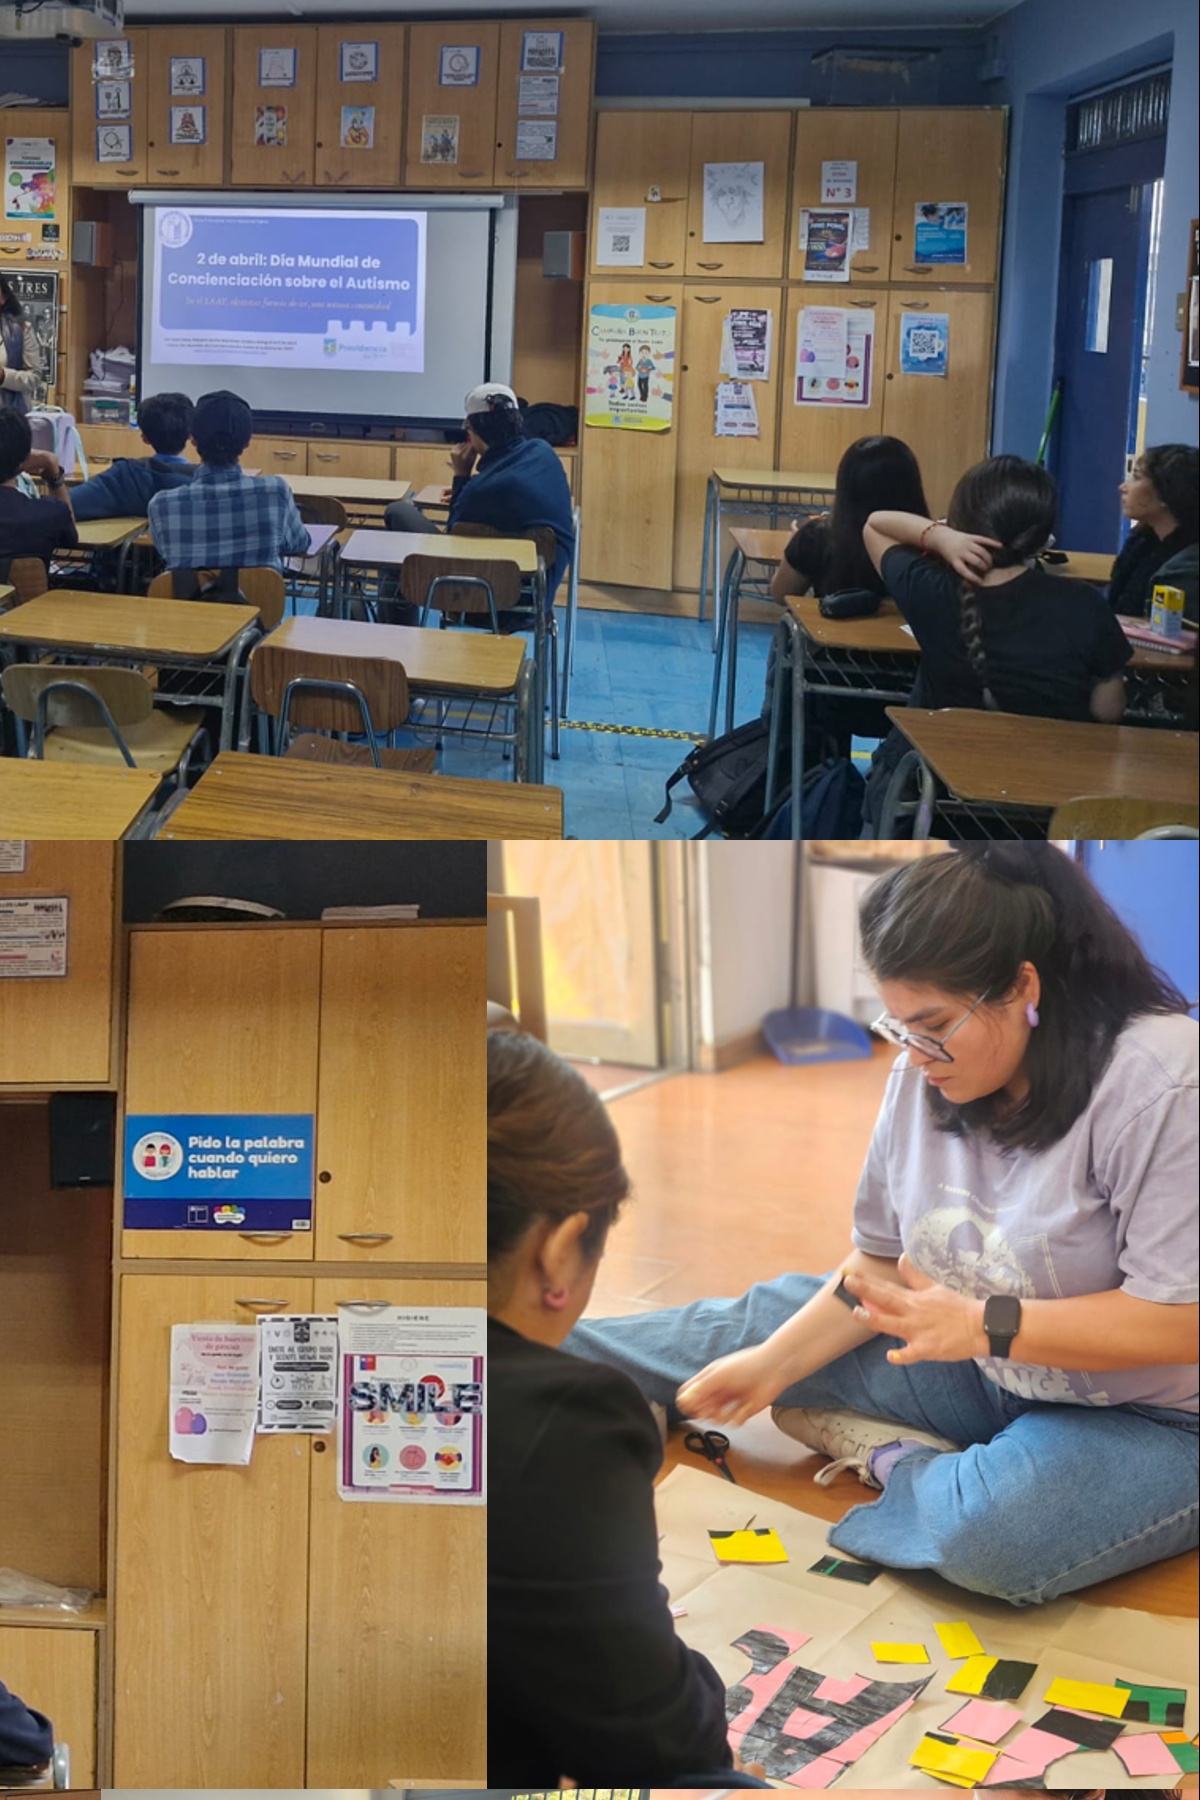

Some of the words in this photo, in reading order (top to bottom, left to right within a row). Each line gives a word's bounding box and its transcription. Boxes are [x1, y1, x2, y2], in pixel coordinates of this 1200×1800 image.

[844, 188, 852, 198] 3
[197, 253, 206, 265] 2
[208, 253, 227, 265] de
[229, 253, 267, 266] abril:
[270, 253, 295, 267] Día
[298, 254, 359, 269] Mundial
[361, 256, 381, 269] de
[18, 281, 48, 295] TRES
[168, 271, 282, 288] Concienciación
[285, 274, 327, 288] sobre
[329, 275, 343, 289] el
[346, 276, 411, 291] Autismo
[339, 343, 388, 355] Providencia
[188, 1135, 222, 1149] Pido
[225, 1135, 241, 1149] la
[244, 1135, 304, 1151] palabra
[188, 1151, 245, 1163] cuando
[248, 1151, 298, 1167] quiero
[188, 1166, 239, 1179] hablar
[349, 1380, 483, 1414] SMILE
